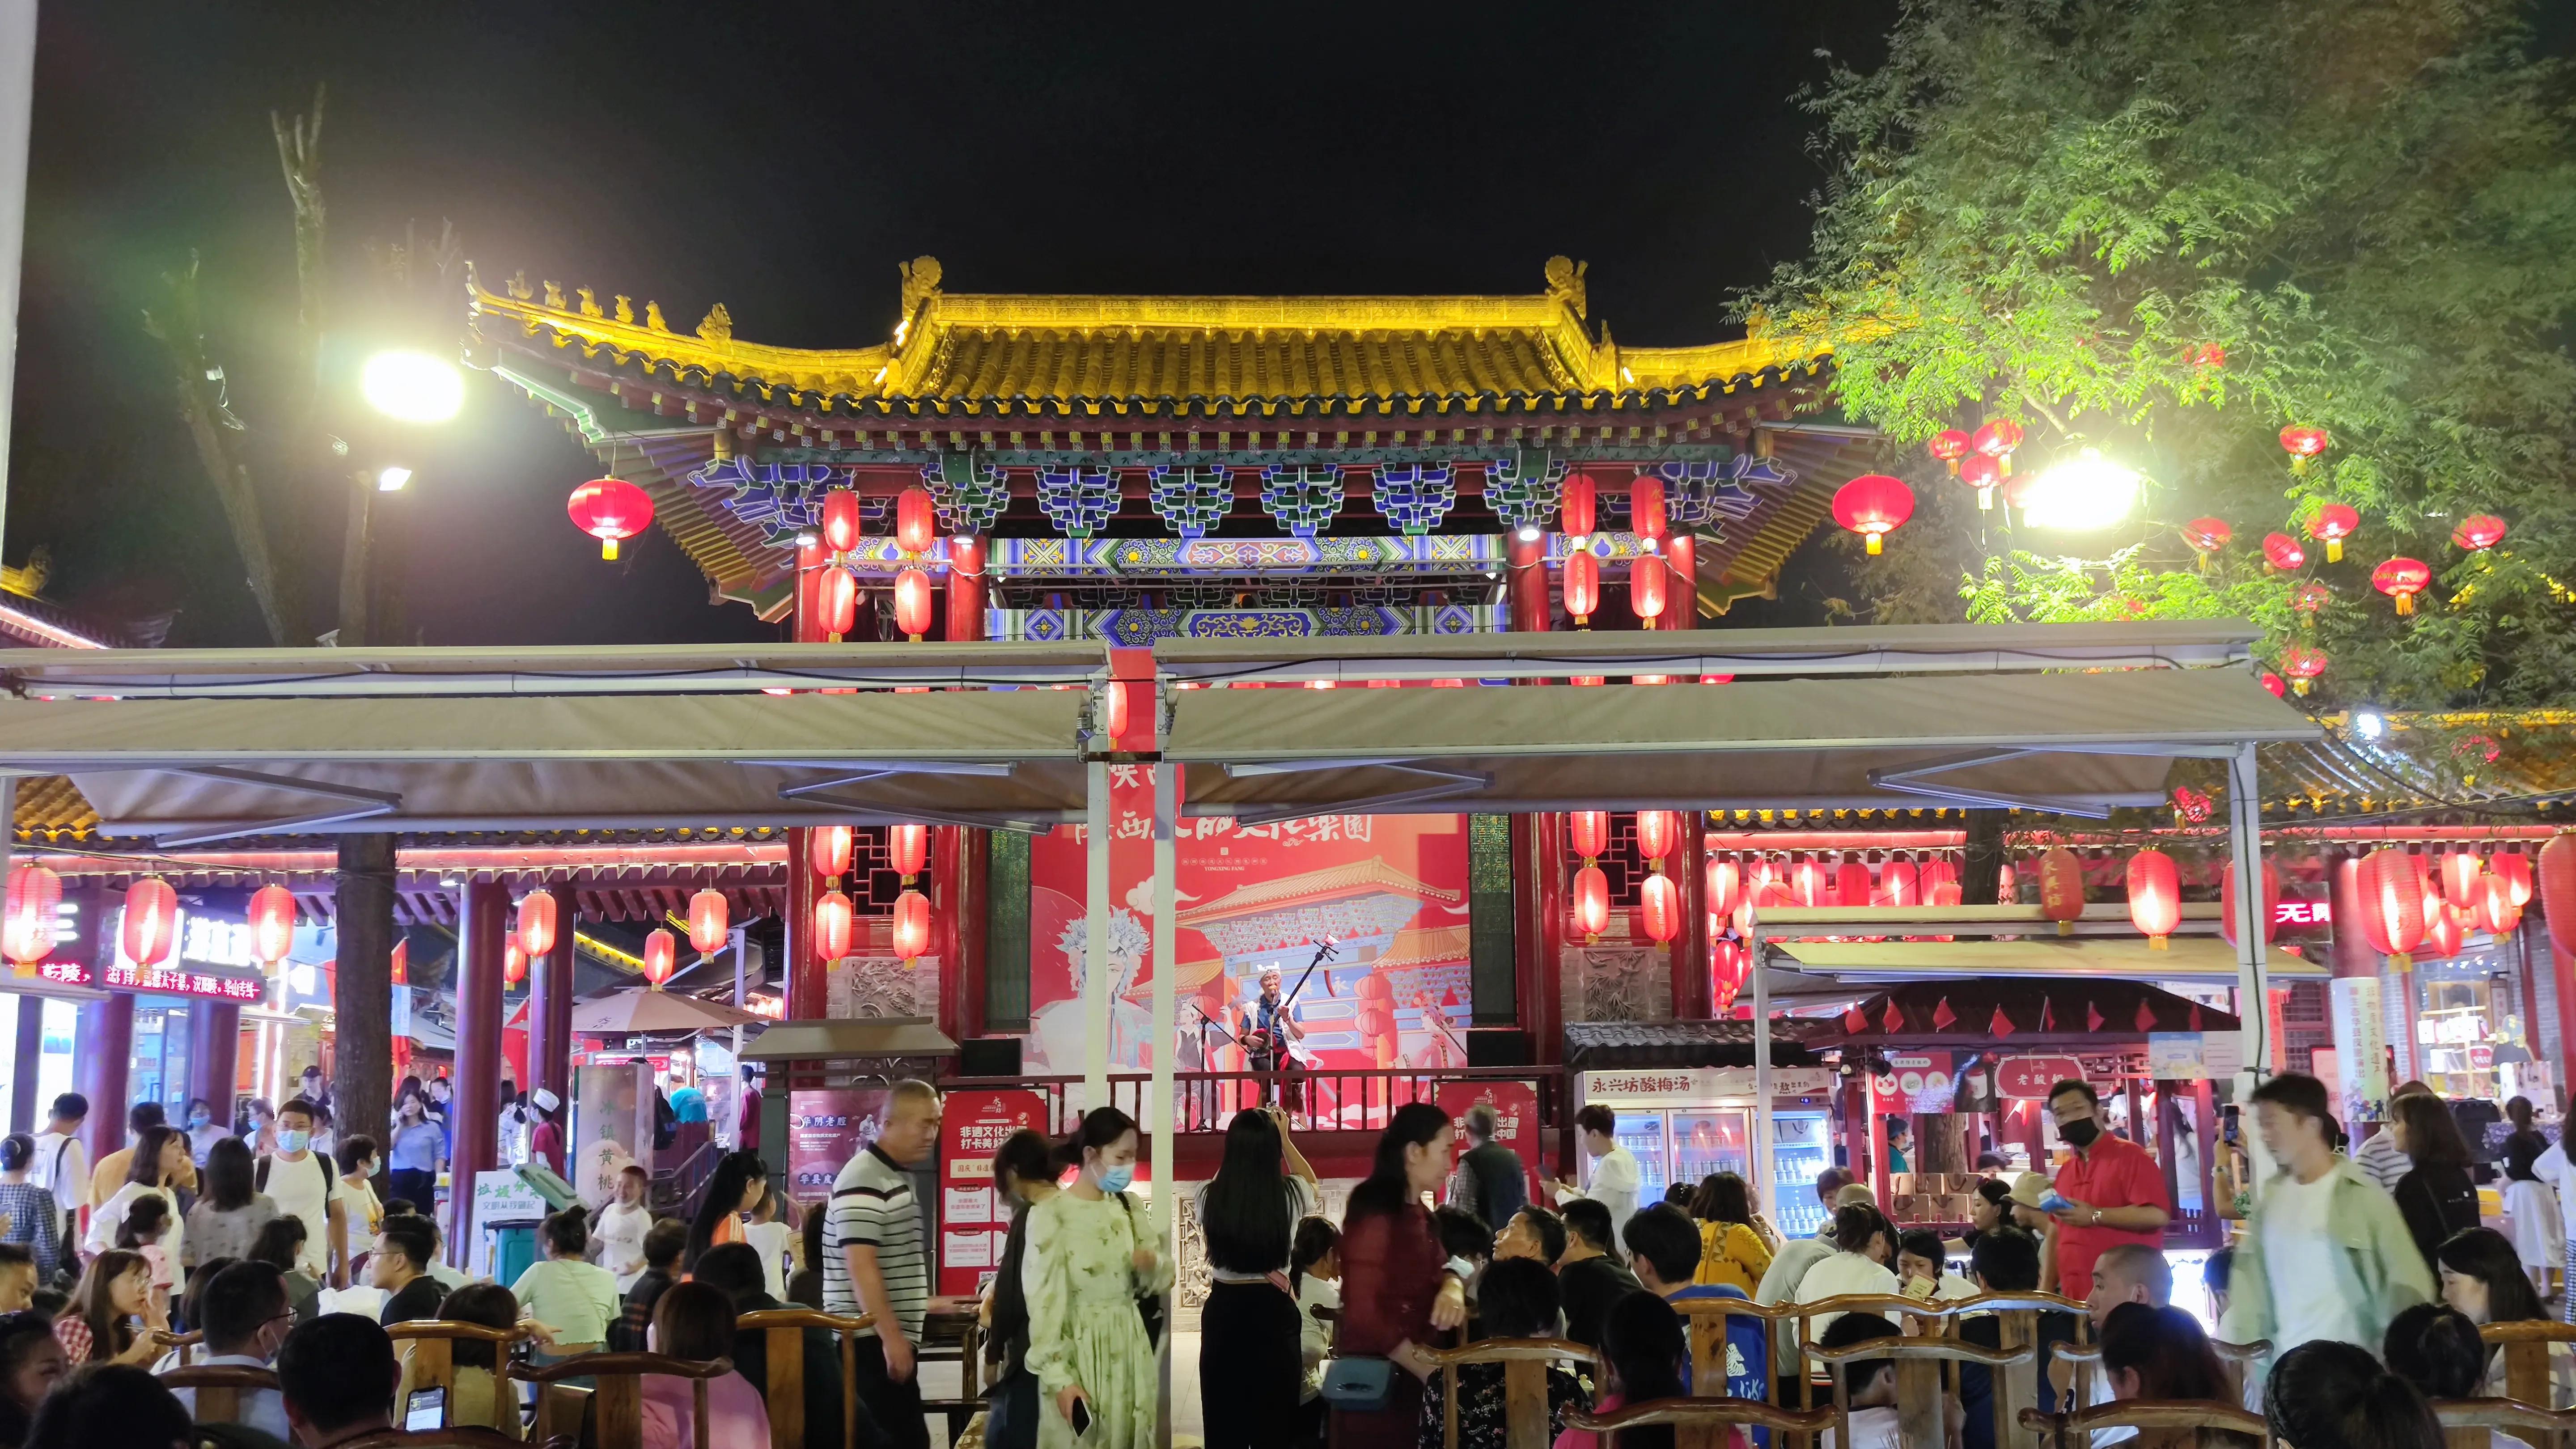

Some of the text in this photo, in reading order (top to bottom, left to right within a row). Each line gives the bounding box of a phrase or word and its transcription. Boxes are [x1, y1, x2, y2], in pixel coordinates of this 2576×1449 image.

[1592, 1076, 1690, 1093] 永兴坊酸梅汤
[2017, 1074, 2064, 1085] 老酸奶
[803, 1116, 847, 1127] 华阴老腔
[597, 1099, 616, 1191] 冰镇黄桃
[483, 1201, 535, 1210] 文明从我做起
